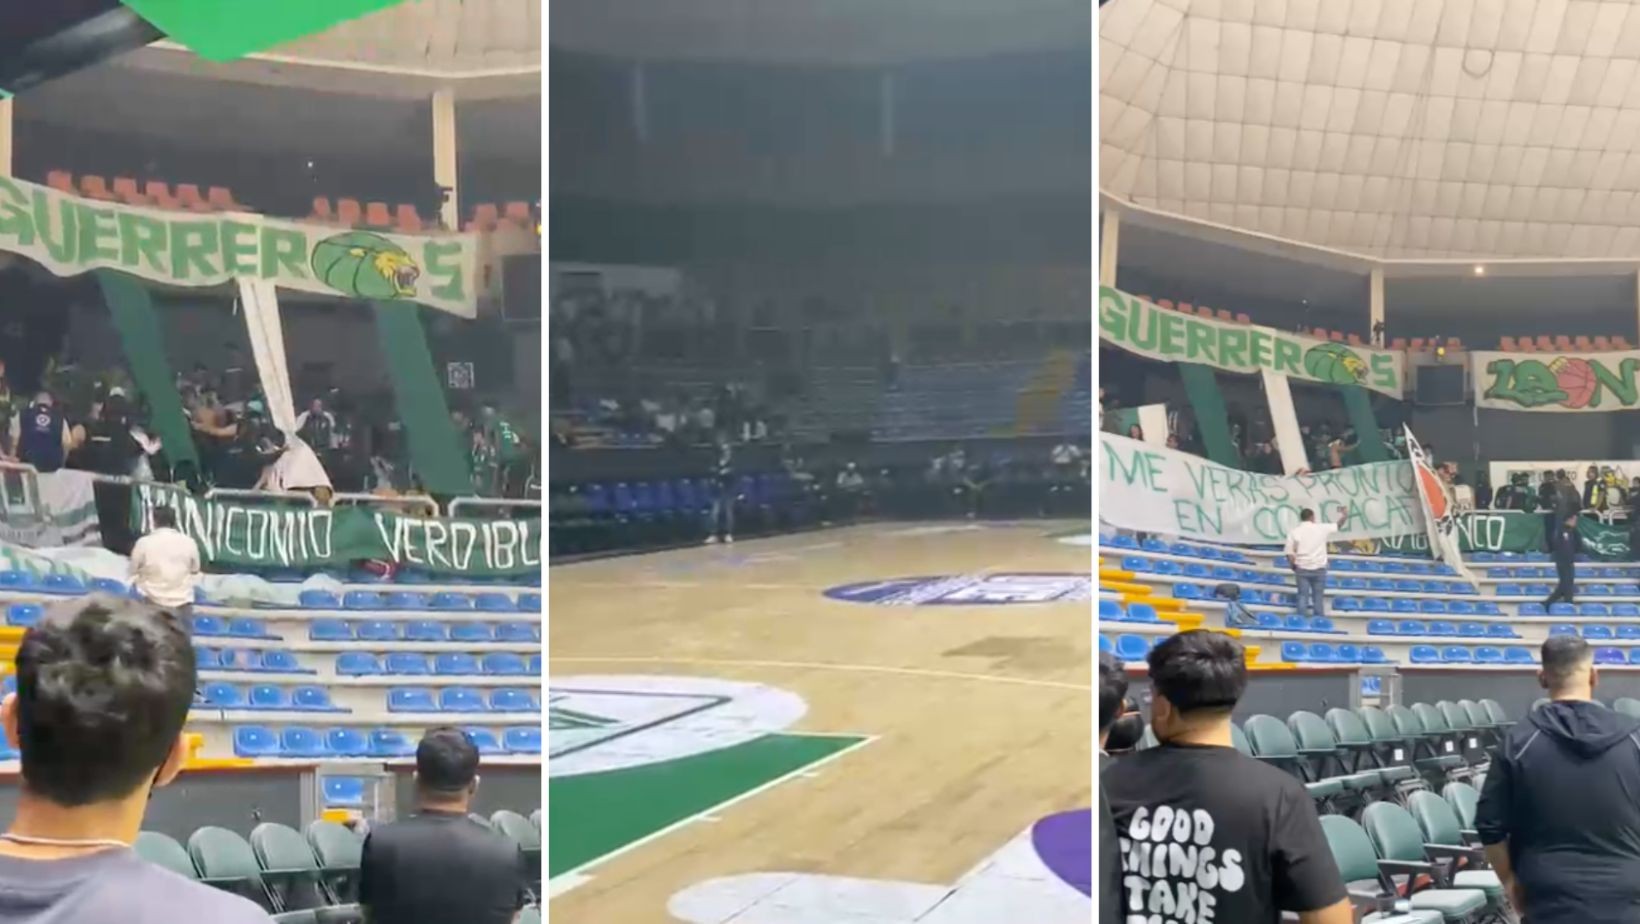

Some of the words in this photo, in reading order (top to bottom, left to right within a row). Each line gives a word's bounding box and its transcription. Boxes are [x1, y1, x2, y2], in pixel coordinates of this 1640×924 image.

[1102, 440, 1168, 492] ME
[1172, 498, 1222, 535] EN
[1128, 805, 1215, 845] GOOD
[1123, 874, 1217, 924] TAKE
